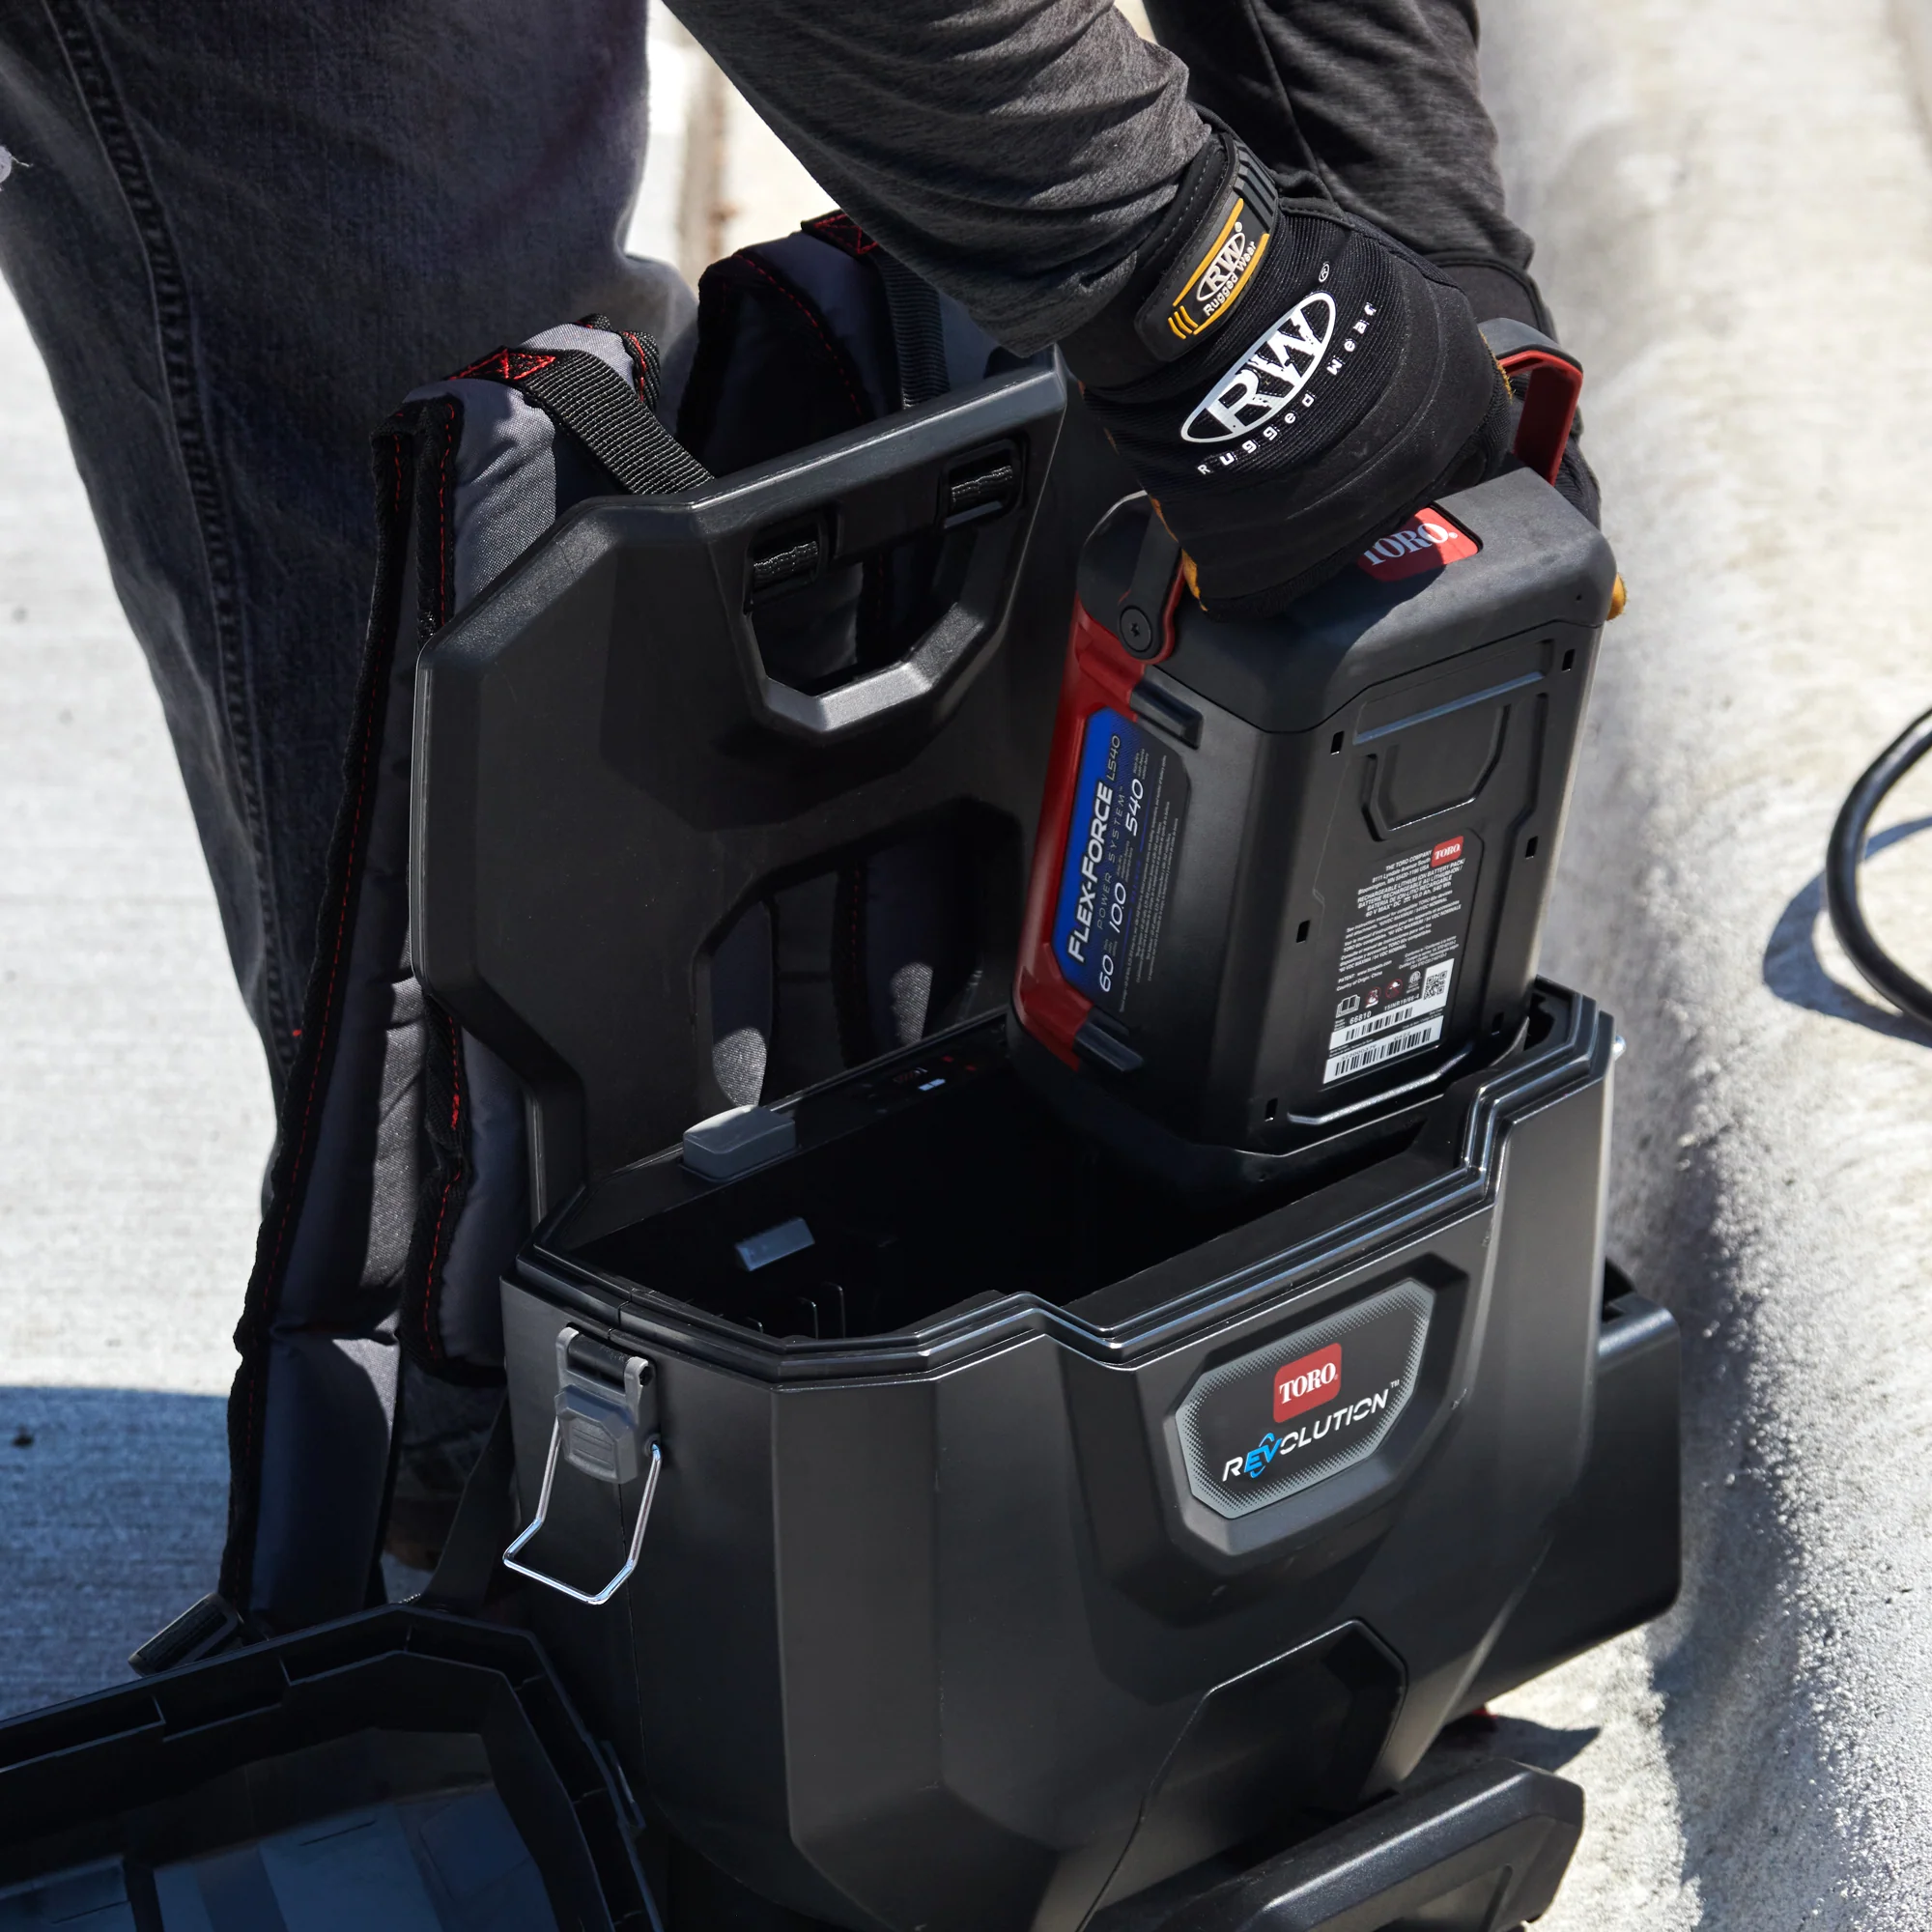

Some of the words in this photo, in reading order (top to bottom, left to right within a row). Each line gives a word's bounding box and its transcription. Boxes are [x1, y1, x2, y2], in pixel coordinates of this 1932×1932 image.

[1203, 272, 1238, 316] Rugged
[1236, 241, 1257, 271] Wear
[1203, 303, 1327, 435] RW
[1197, 390, 1316, 474] Rugged
[1125, 779, 1144, 837] 540
[1067, 781, 1114, 963] FLEX-FORCE
[1106, 735, 1121, 781] L540
[1396, 859, 1408, 867] TORO
[1409, 849, 1432, 862] COMPANY
[1435, 843, 1461, 860] TORO
[1096, 872, 1113, 930] POWER
[1109, 882, 1126, 933] 10.0
[1099, 953, 1114, 993] 60
[1350, 1010, 1372, 1024] 66810
[1279, 1362, 1336, 1404] TORO
[1222, 1388, 1389, 1481] REVOLUTION
